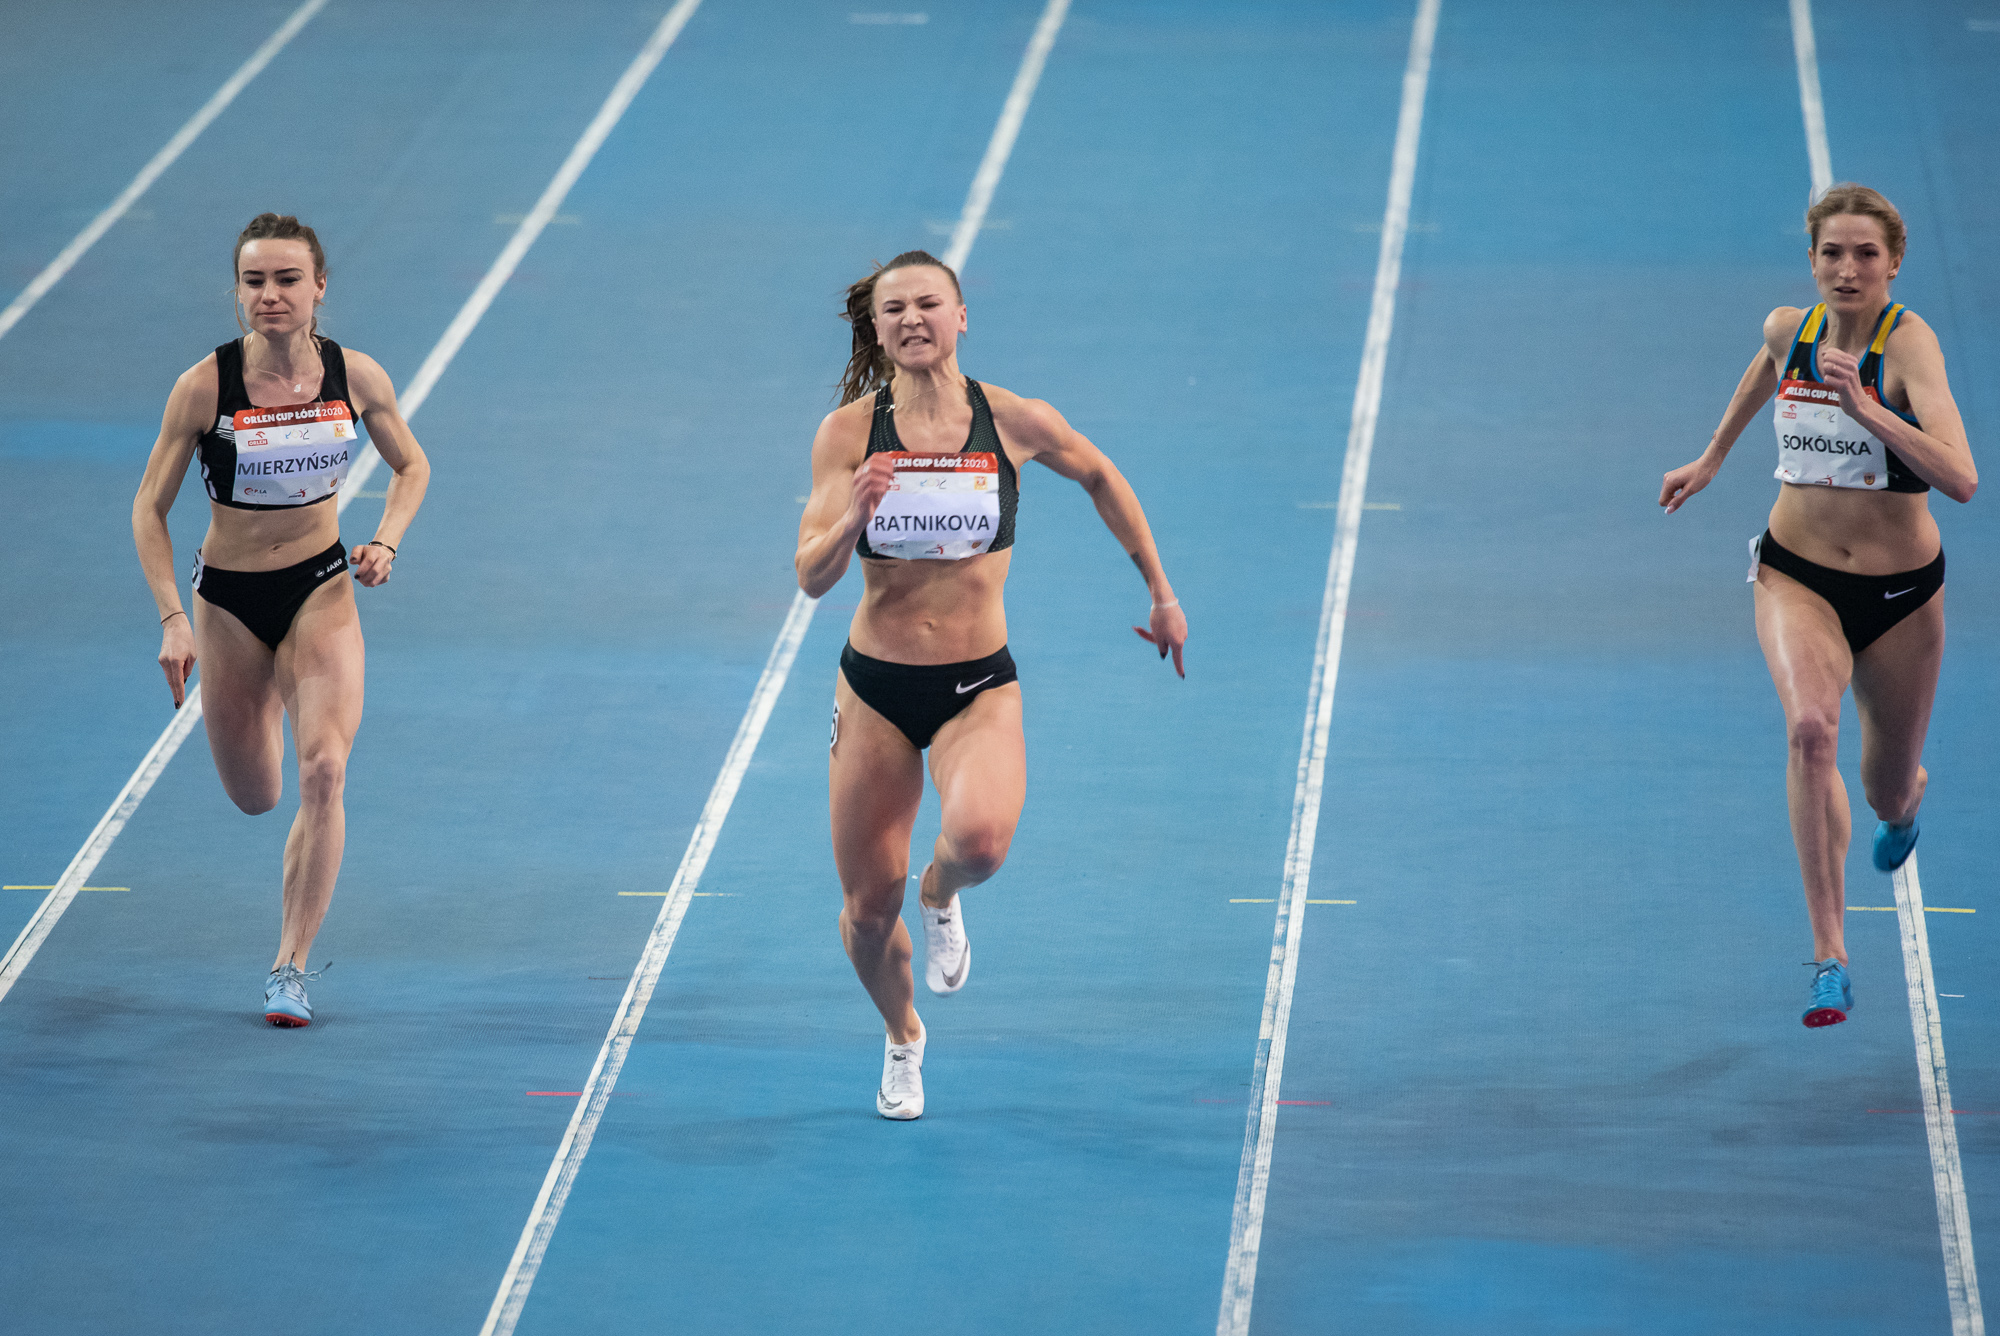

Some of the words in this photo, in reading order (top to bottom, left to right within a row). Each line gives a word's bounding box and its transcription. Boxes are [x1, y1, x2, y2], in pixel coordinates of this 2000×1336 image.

[1811, 389, 1828, 399] CUP
[243, 413, 275, 425] ORLEN
[276, 411, 294, 422] CUP
[295, 407, 321, 419] ŁÓDŹ
[322, 406, 343, 417] 2020
[1783, 434, 1872, 456] SOKÓLSKA
[237, 450, 349, 476] MIERZYŃSKA
[913, 458, 933, 468] CUP
[933, 456, 963, 468] ŁÓDŹ
[964, 458, 988, 469] 2020
[874, 514, 990, 532] RATNIKOVA
[326, 558, 343, 573] JAKO
